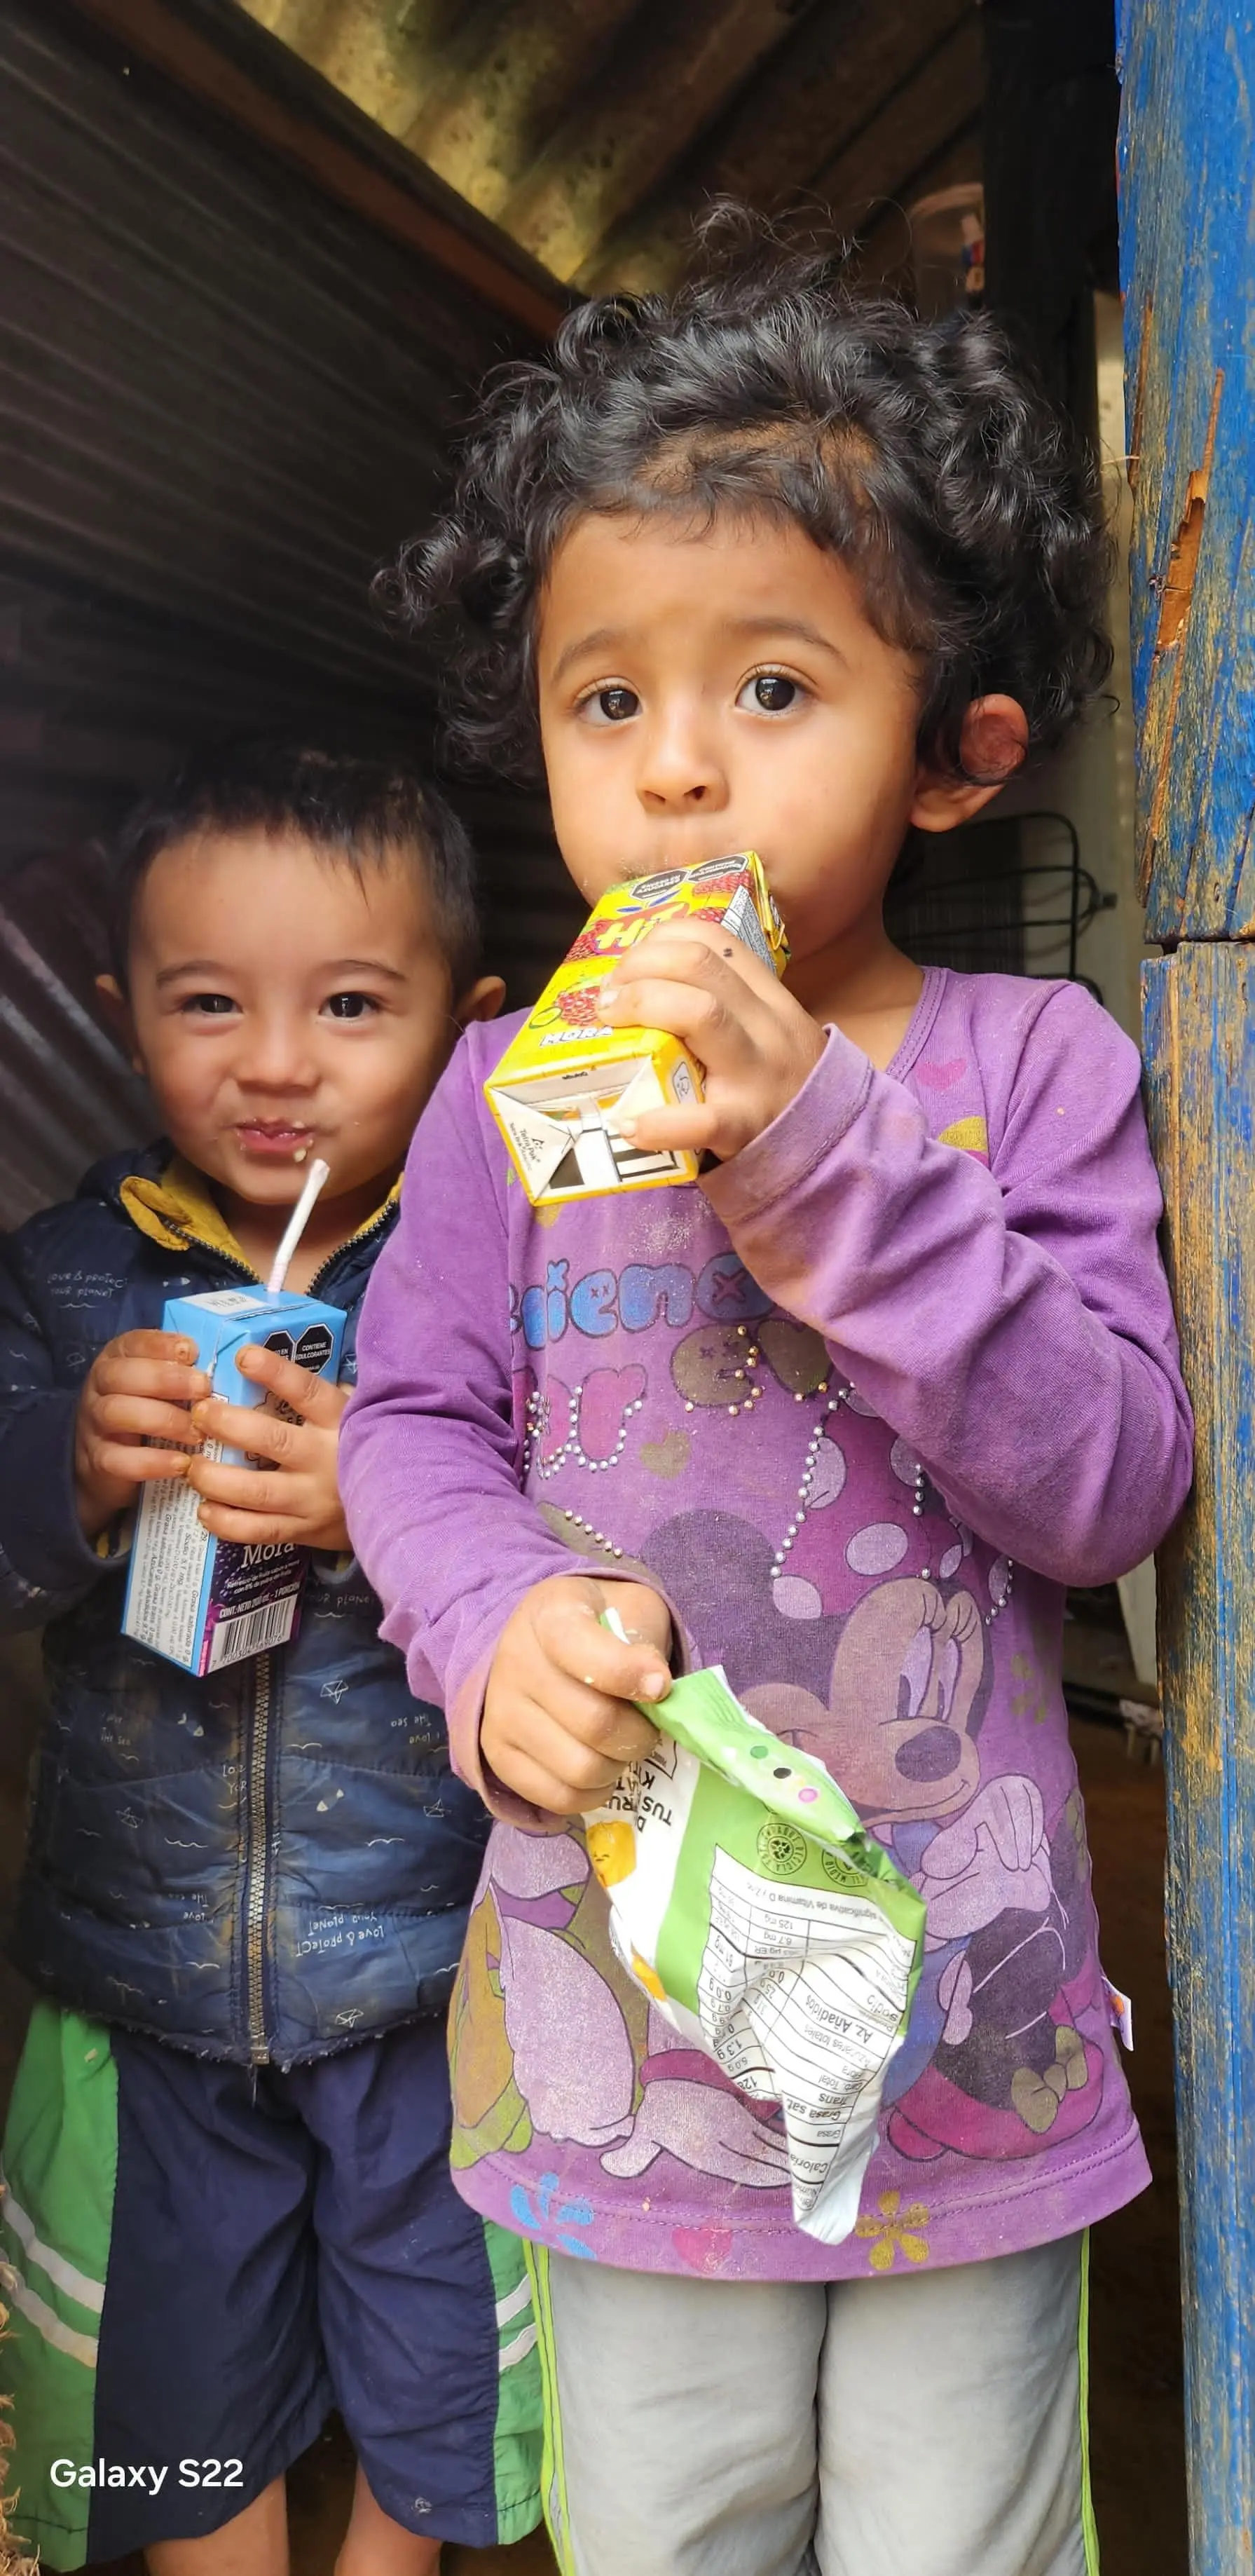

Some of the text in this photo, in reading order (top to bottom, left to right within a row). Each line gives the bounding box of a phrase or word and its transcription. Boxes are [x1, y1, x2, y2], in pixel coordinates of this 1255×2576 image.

[296, 1348, 331, 1360] EDULCORANTES
[301, 1341, 328, 1351] CONTIENE
[163, 1513, 172, 1535] Grasa
[182, 1532, 191, 1555] Sodio
[189, 1590, 198, 1612] Grasa
[800, 1995, 856, 2033] Añadidos
[788, 2099, 810, 2114] sat.
[809, 2104, 841, 2125] Grasa
